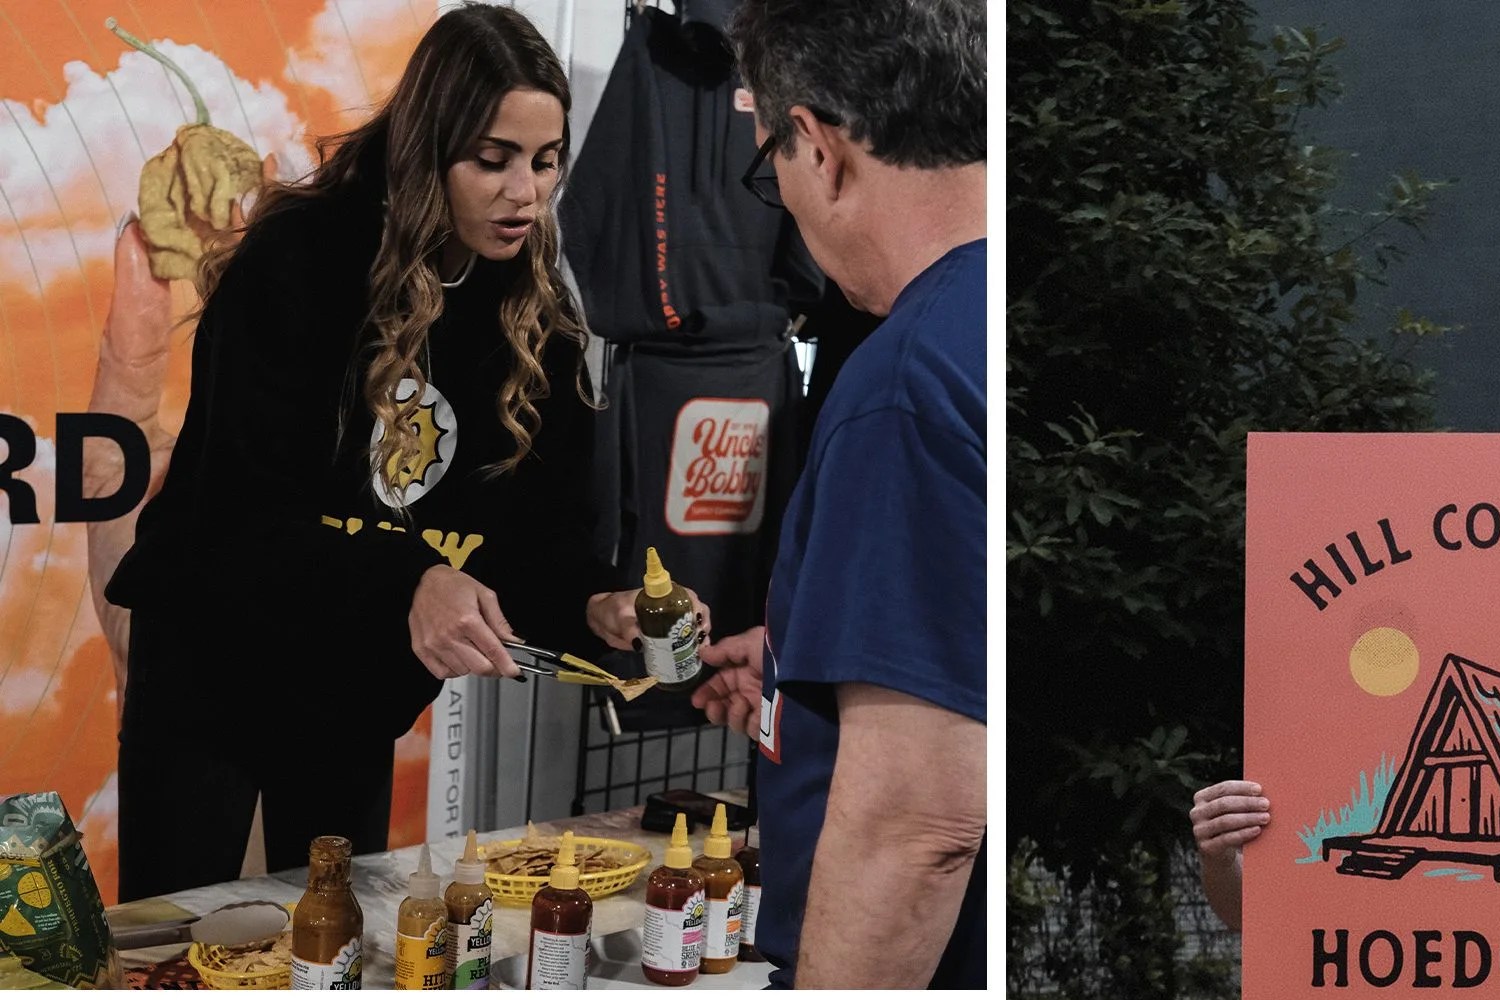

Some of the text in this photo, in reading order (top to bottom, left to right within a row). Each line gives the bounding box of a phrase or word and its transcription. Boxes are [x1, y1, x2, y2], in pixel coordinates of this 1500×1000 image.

[655, 172, 667, 223] HERE
[656, 229, 667, 272] WAS
[692, 418, 764, 458] Uncle
[683, 456, 762, 498] Bobby
[1290, 518, 1412, 611] HILL
[445, 768, 460, 824] FOR
